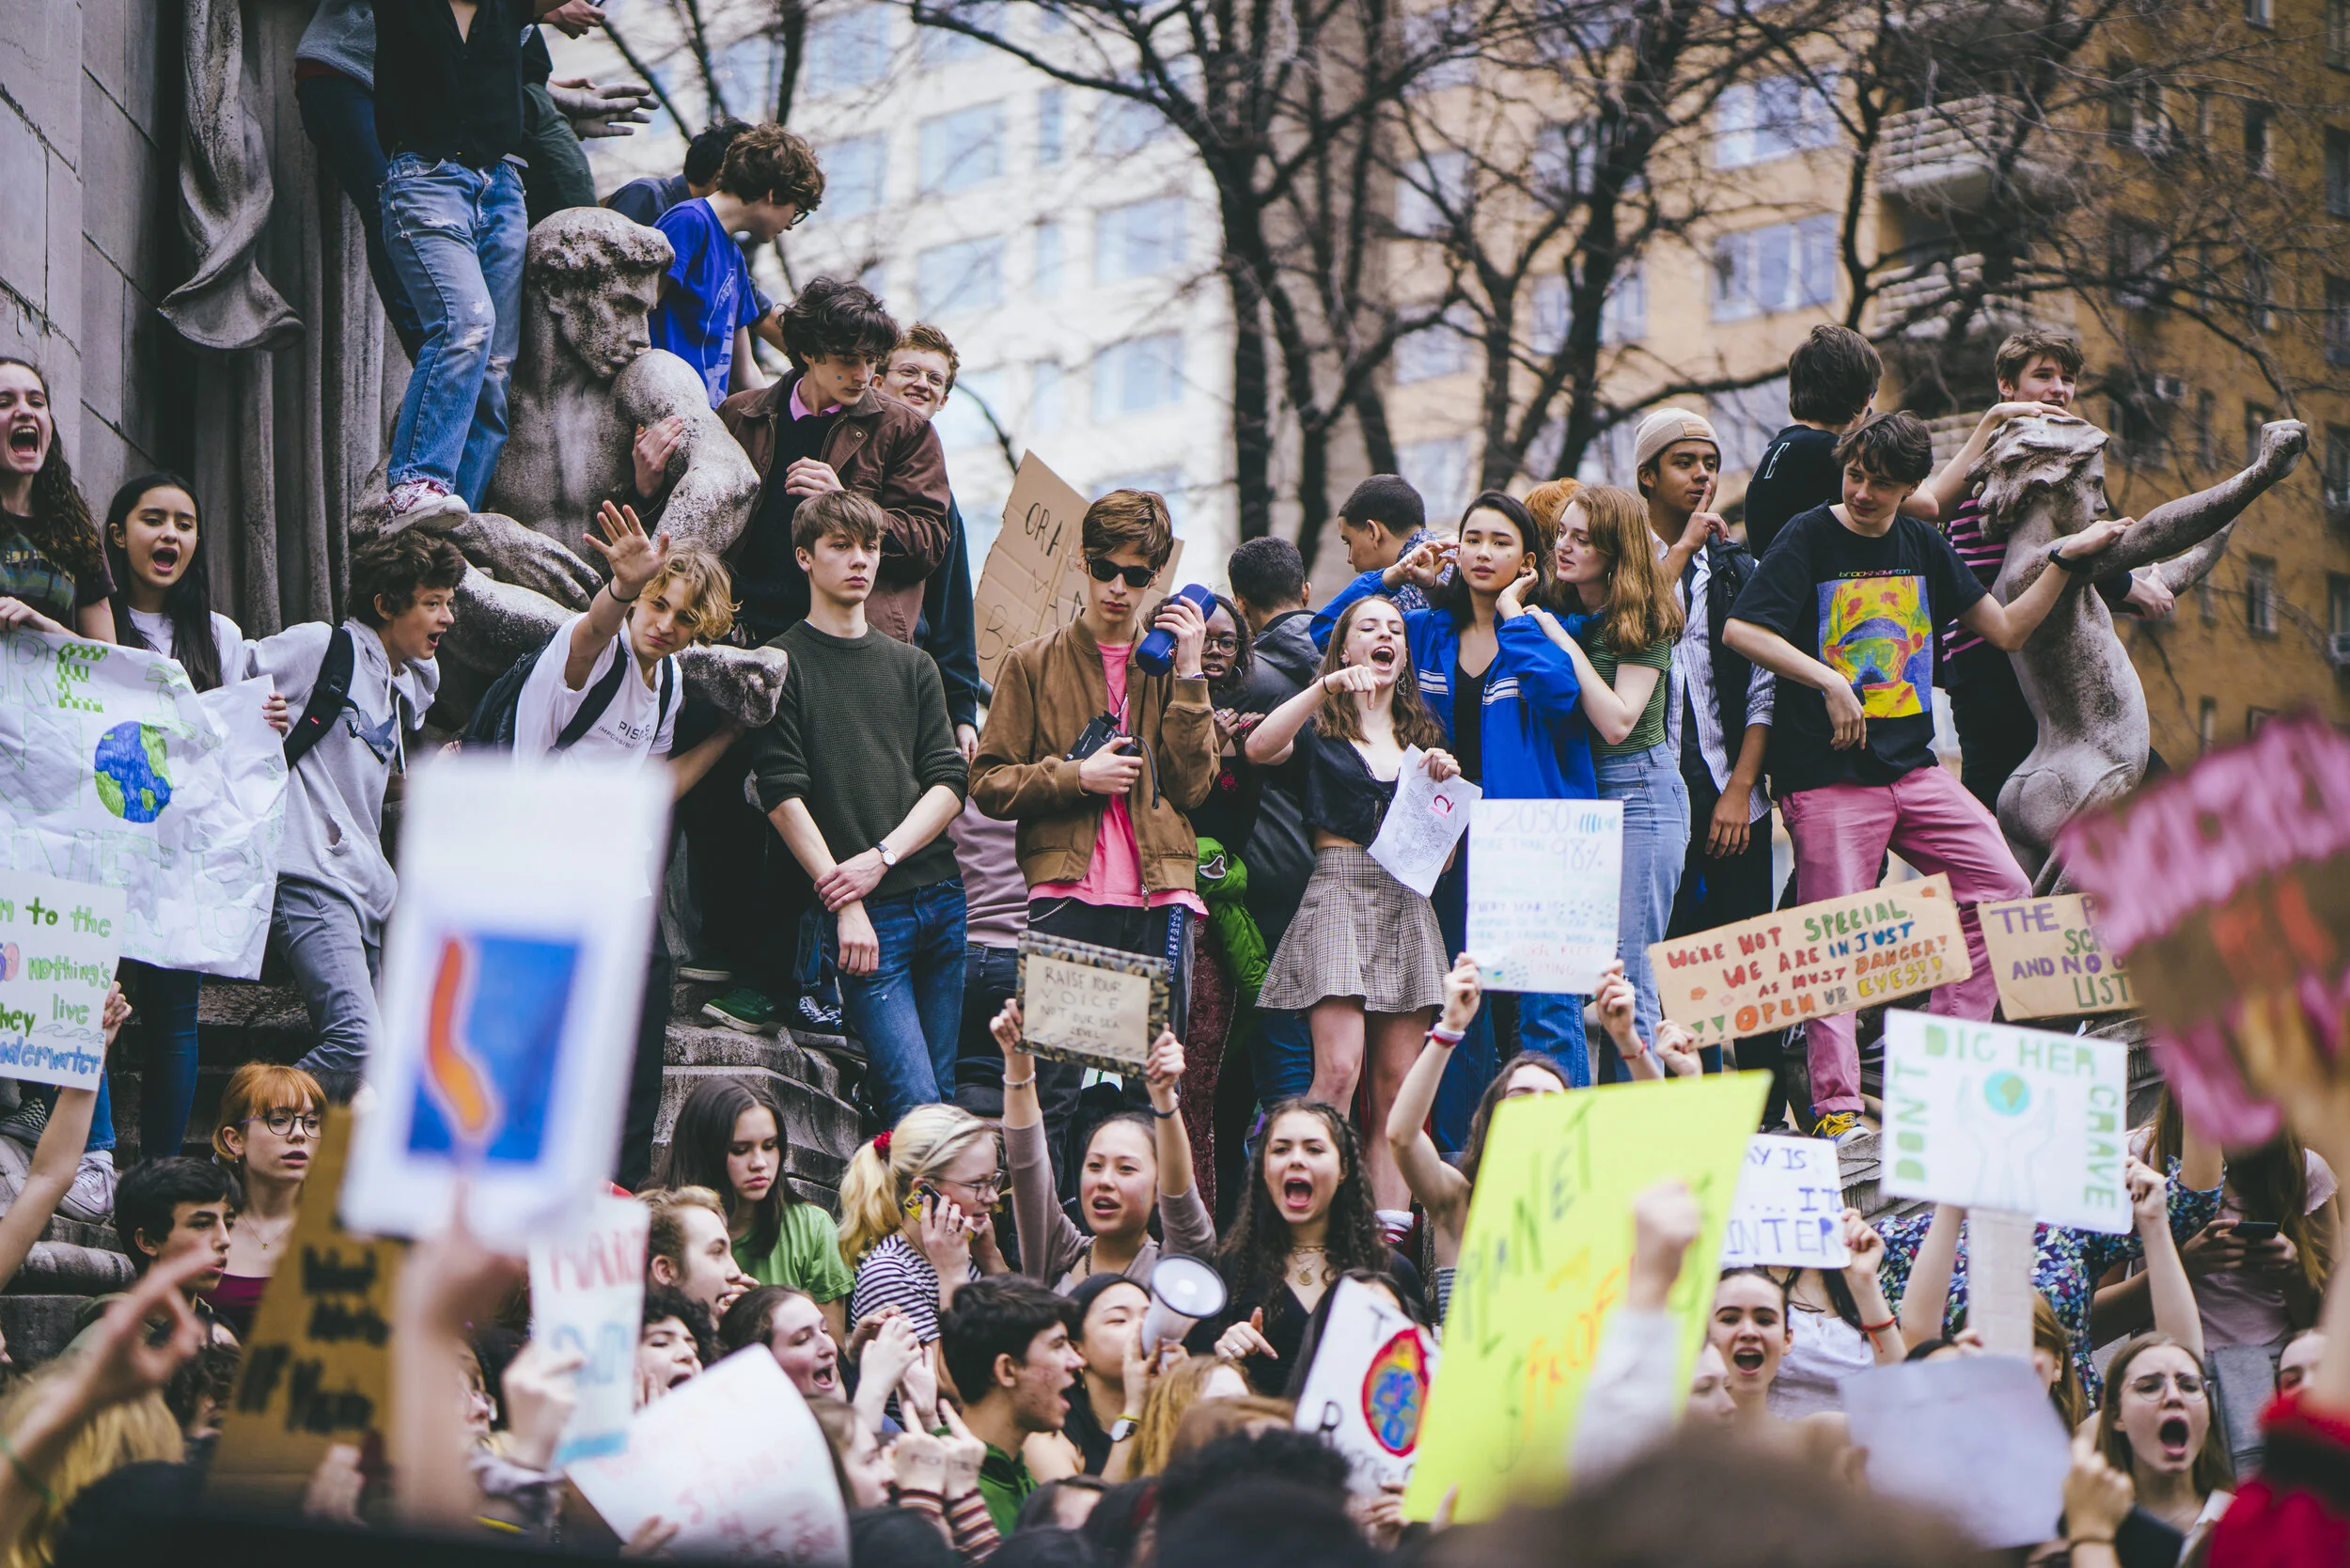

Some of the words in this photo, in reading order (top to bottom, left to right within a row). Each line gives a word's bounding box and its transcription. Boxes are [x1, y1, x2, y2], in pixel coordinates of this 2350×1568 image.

[1495, 801, 1571, 834] 2050
[1550, 837, 1604, 871] 98%
[25, 897, 58, 926] to
[70, 905, 112, 938] the
[1989, 902, 2060, 934] THE
[1737, 926, 1782, 956] NOT
[1045, 966, 1086, 990] RAISE
[1092, 976, 1122, 993] YOUR
[1722, 960, 1762, 989] WE
[1778, 947, 1821, 973] ARE
[2012, 957, 2056, 980] AND
[2061, 953, 2103, 974] NO
[1040, 987, 1120, 1011] VOICE
[1758, 981, 1779, 998] AS
[53, 994, 90, 1026] live
[1040, 1005, 1068, 1019] NOT
[1735, 993, 1815, 1032] OPEN
[1824, 986, 1849, 1005] UR
[1924, 1023, 1998, 1063] DIG
